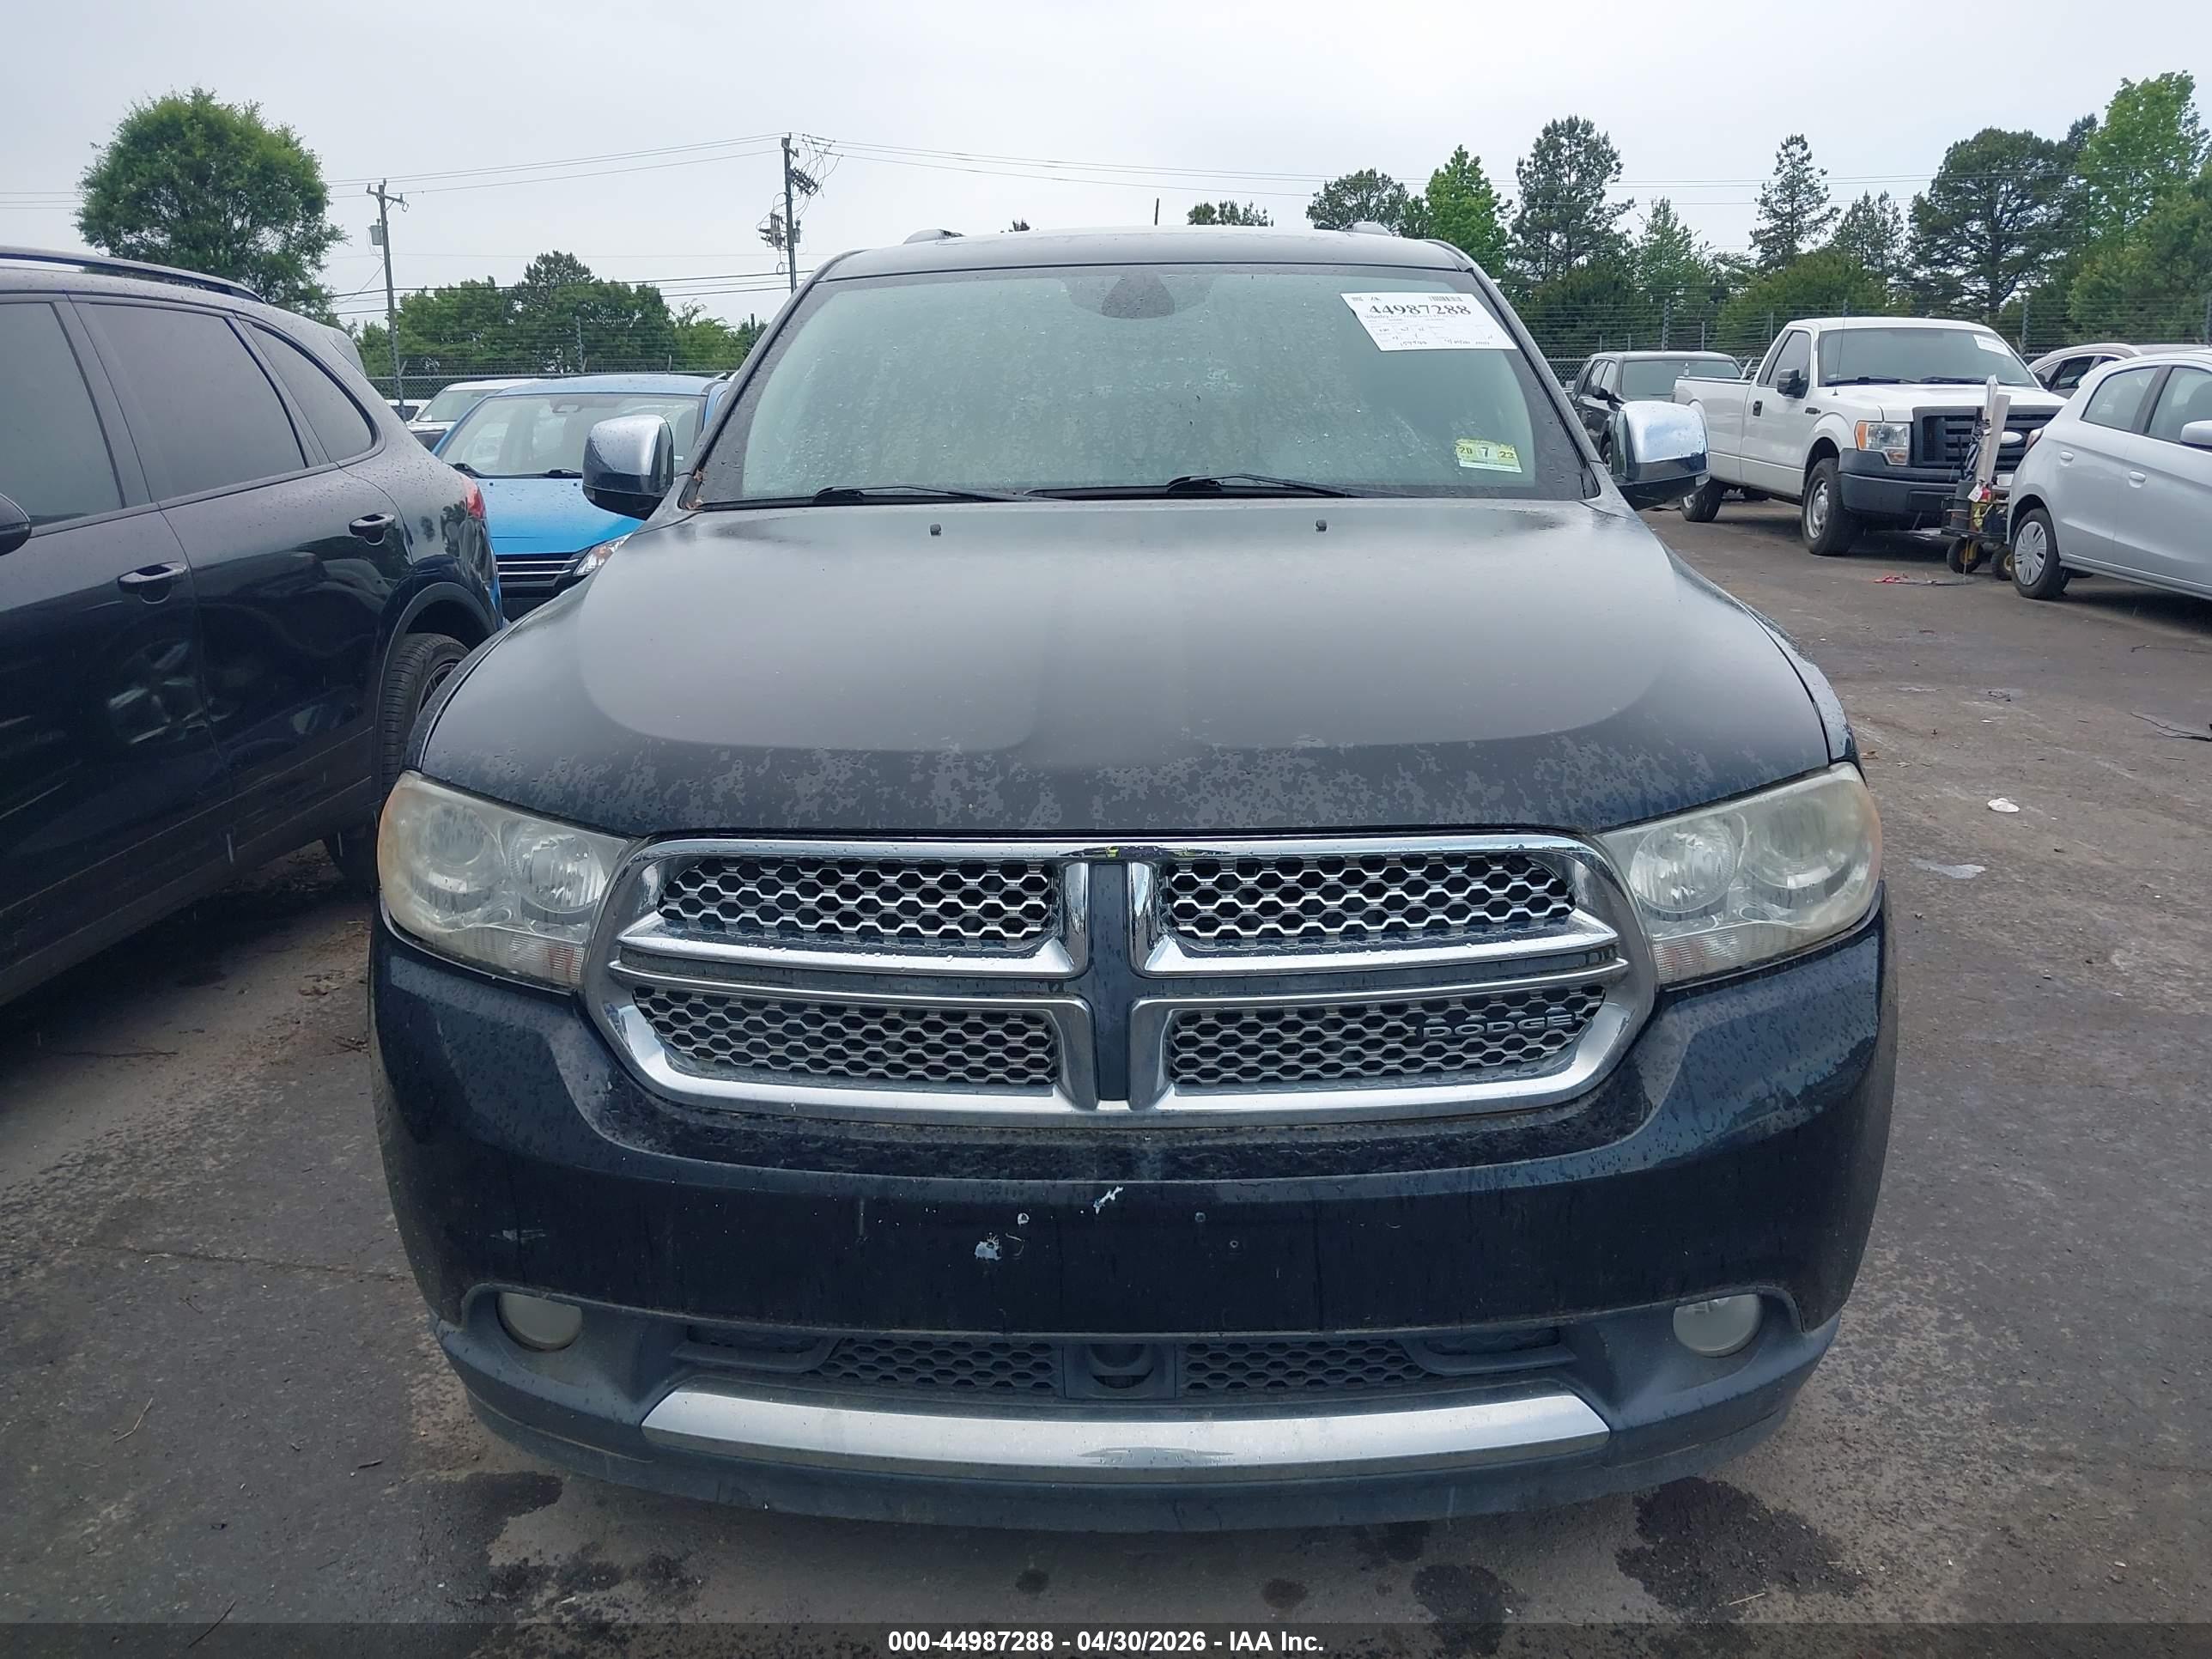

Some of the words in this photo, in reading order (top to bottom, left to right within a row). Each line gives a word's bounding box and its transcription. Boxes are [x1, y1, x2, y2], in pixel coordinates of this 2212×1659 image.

[1369, 304, 1472, 315] 44987288
[1480, 446, 1490, 458] 7
[1423, 1013, 1574, 1038] DODGE
